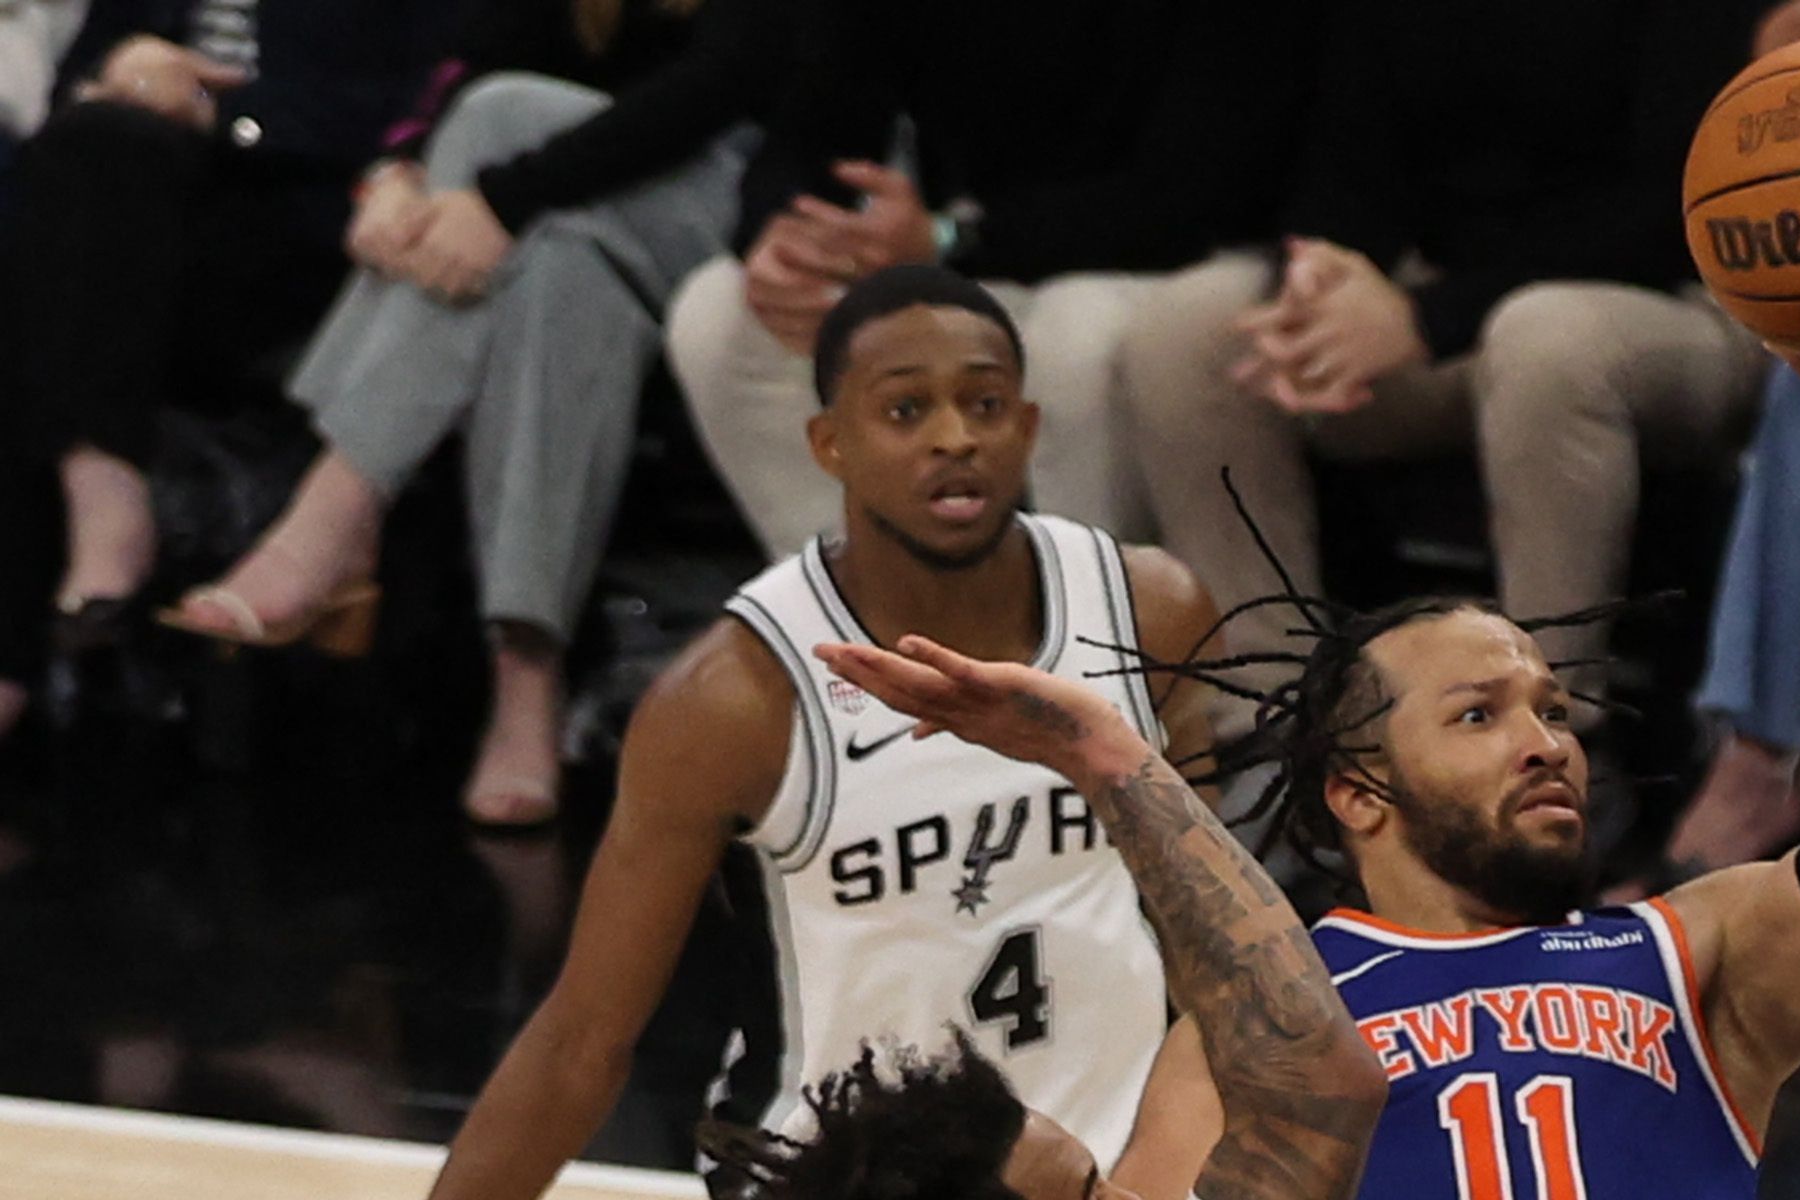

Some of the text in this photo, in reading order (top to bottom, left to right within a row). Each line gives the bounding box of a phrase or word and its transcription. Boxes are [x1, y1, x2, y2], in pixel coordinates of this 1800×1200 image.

[830, 786, 1096, 918] SPUR
[965, 922, 1054, 1057] 4
[1355, 983, 1678, 1094] EW YORK
